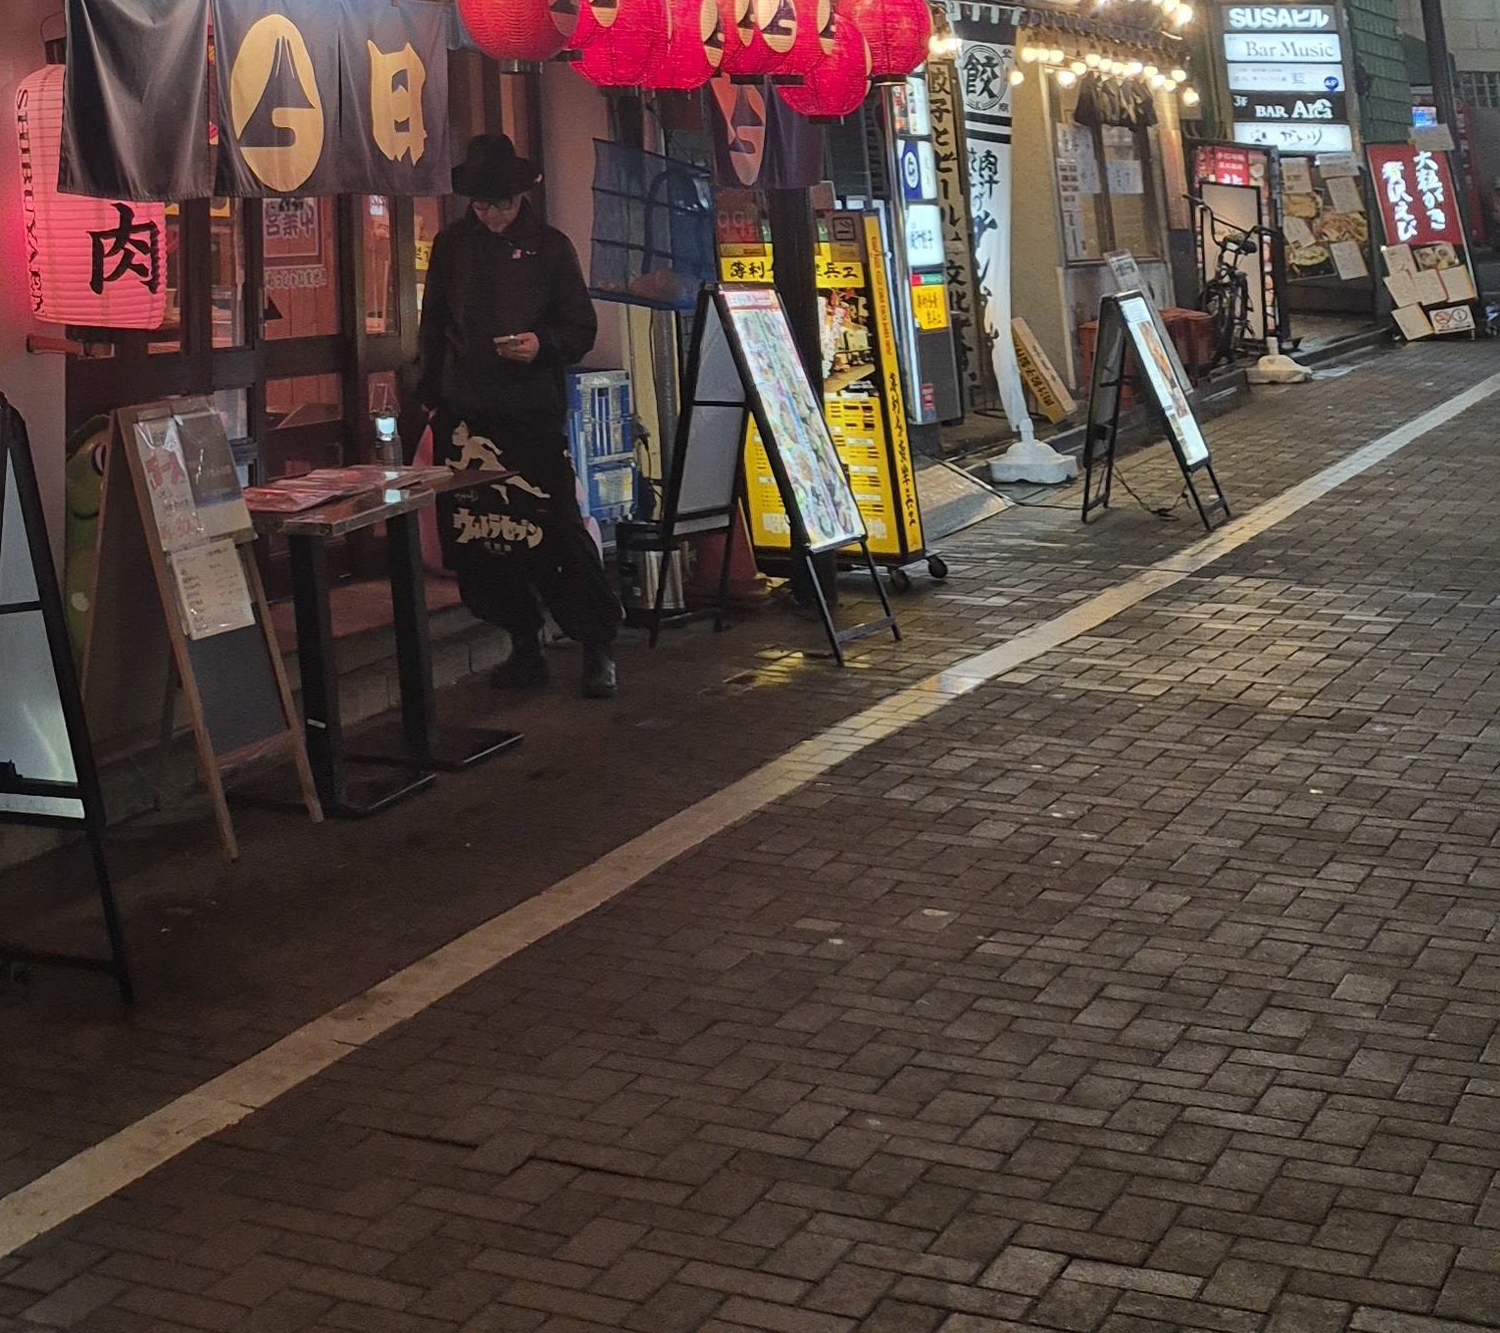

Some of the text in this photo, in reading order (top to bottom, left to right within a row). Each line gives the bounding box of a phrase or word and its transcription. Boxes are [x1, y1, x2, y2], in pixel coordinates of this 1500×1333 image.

[1228, 6, 1330, 29] SUSAビル
[1244, 40, 1336, 58] Bar Music
[963, 52, 1000, 100] 餃
[1233, 95, 1248, 107] 3F
[1254, 105, 1289, 119] BAR
[88, 201, 162, 295] 肉
